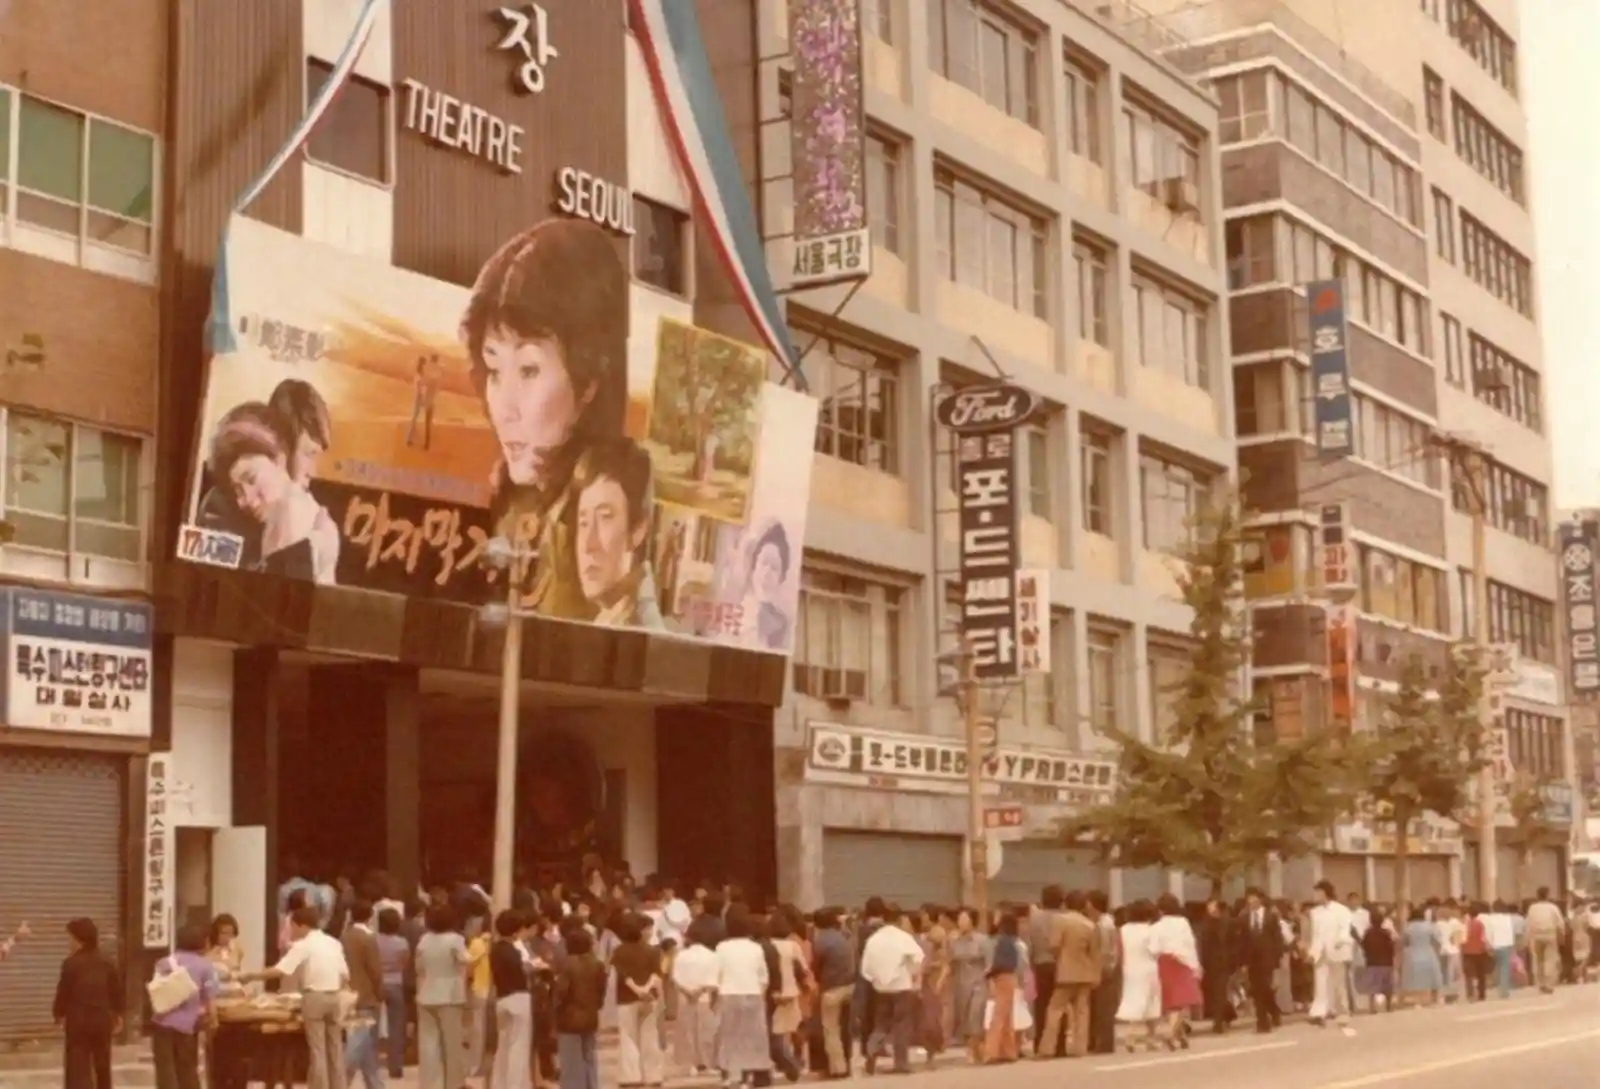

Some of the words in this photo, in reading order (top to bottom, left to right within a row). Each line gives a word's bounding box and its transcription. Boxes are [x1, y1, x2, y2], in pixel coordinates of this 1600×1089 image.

[497, 3, 560, 95] 장
[404, 78, 525, 175] THEATRE
[556, 165, 637, 236] SEOUL
[793, 235, 862, 277] 서울극장
[950, 390, 1018, 426] Ford
